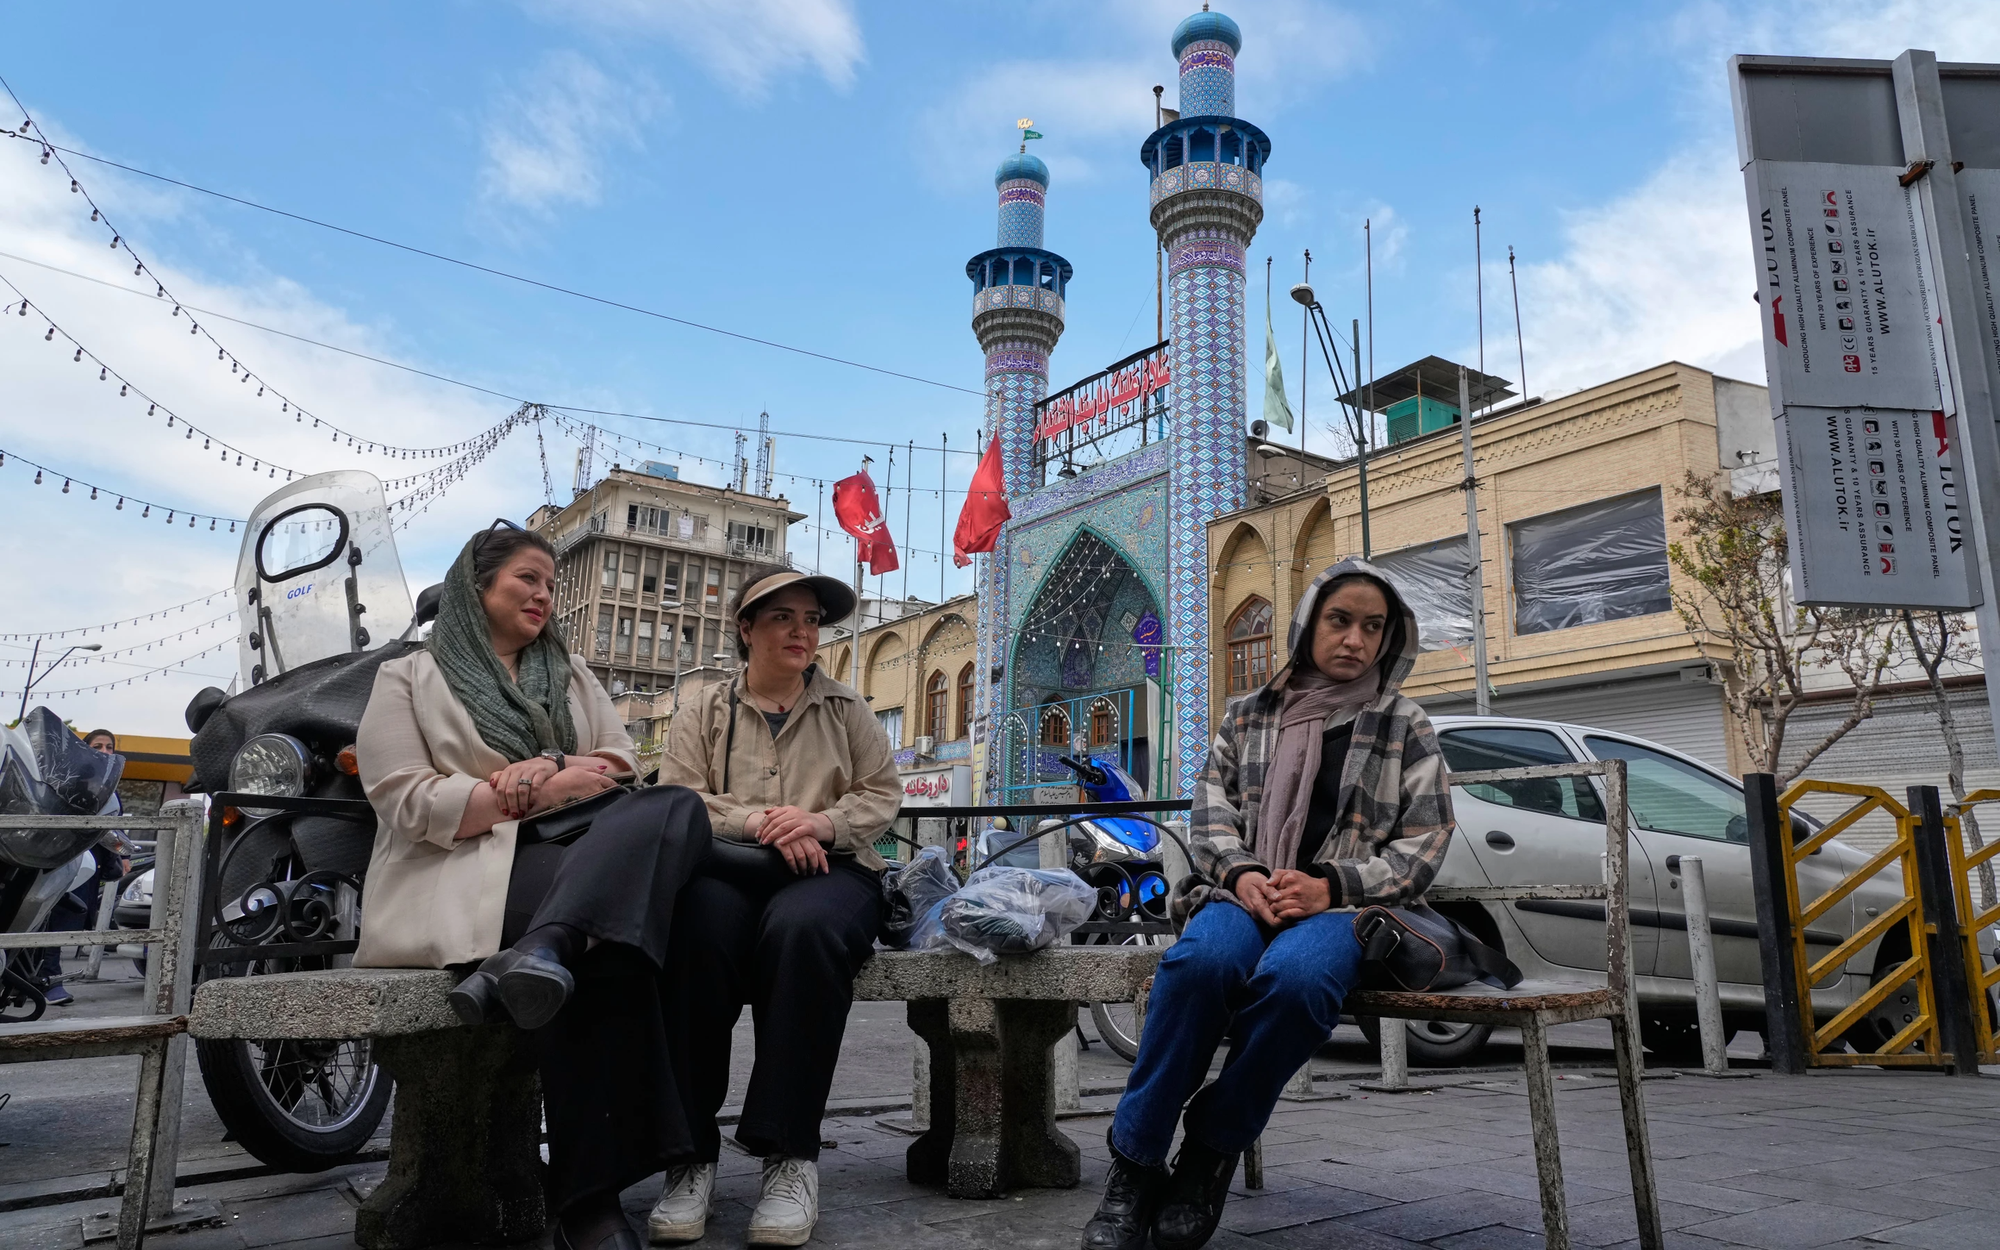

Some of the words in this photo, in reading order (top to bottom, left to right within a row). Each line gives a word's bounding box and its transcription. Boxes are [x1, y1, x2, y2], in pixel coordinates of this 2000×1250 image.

[1846, 189, 1858, 237] ASSURANCE
[1969, 193, 1977, 214] PANEL
[1784, 208, 1794, 246] COMPOSITE
[1972, 216, 1984, 254] COMPOSITE
[1807, 227, 1818, 268] EXPERIENCE
[1853, 239, 1862, 265] YEARS
[1790, 247, 1799, 283] ALUMINUM
[1813, 270, 1819, 279] OF
[1858, 268, 1864, 276] 10
[1979, 255, 1990, 290] ALUMINUM
[1865, 228, 1890, 334] WWW.ALUTOK.ir
[1795, 284, 1803, 312] QUALITY
[1818, 303, 1824, 311] 30
[1861, 288, 1872, 332] GUARANTY
[1986, 291, 1995, 319] QUALITY
[1800, 332, 1810, 372] PRODUCING
[1867, 335, 1876, 363] YEARS
[1872, 366, 1877, 374] 15
[1097, 385, 1110, 426] یا
[1844, 417, 1856, 463] GUARANTY
[1891, 420, 1899, 438] WITH
[1912, 419, 1920, 437] HIGH
[1893, 439, 1900, 447] 30
[1915, 438, 1925, 469] QUALITY
[1826, 415, 1849, 531] WWW.ALUTOK.ir
[1895, 449, 1904, 473] YEARS
[1852, 477, 1859, 485] 10
[1898, 474, 1905, 484] OF
[1919, 470, 1930, 508] ALUMINUM
[1853, 489, 1863, 518] YEARS
[1900, 486, 1912, 531] EXPERIENCE
[1924, 510, 1936, 552] COMPOSITE
[1857, 521, 1870, 575] ASSURANCE
[1931, 554, 1939, 578] PANEL
[287, 584, 313, 600] GOLF
[905, 774, 949, 798] داروخانه
